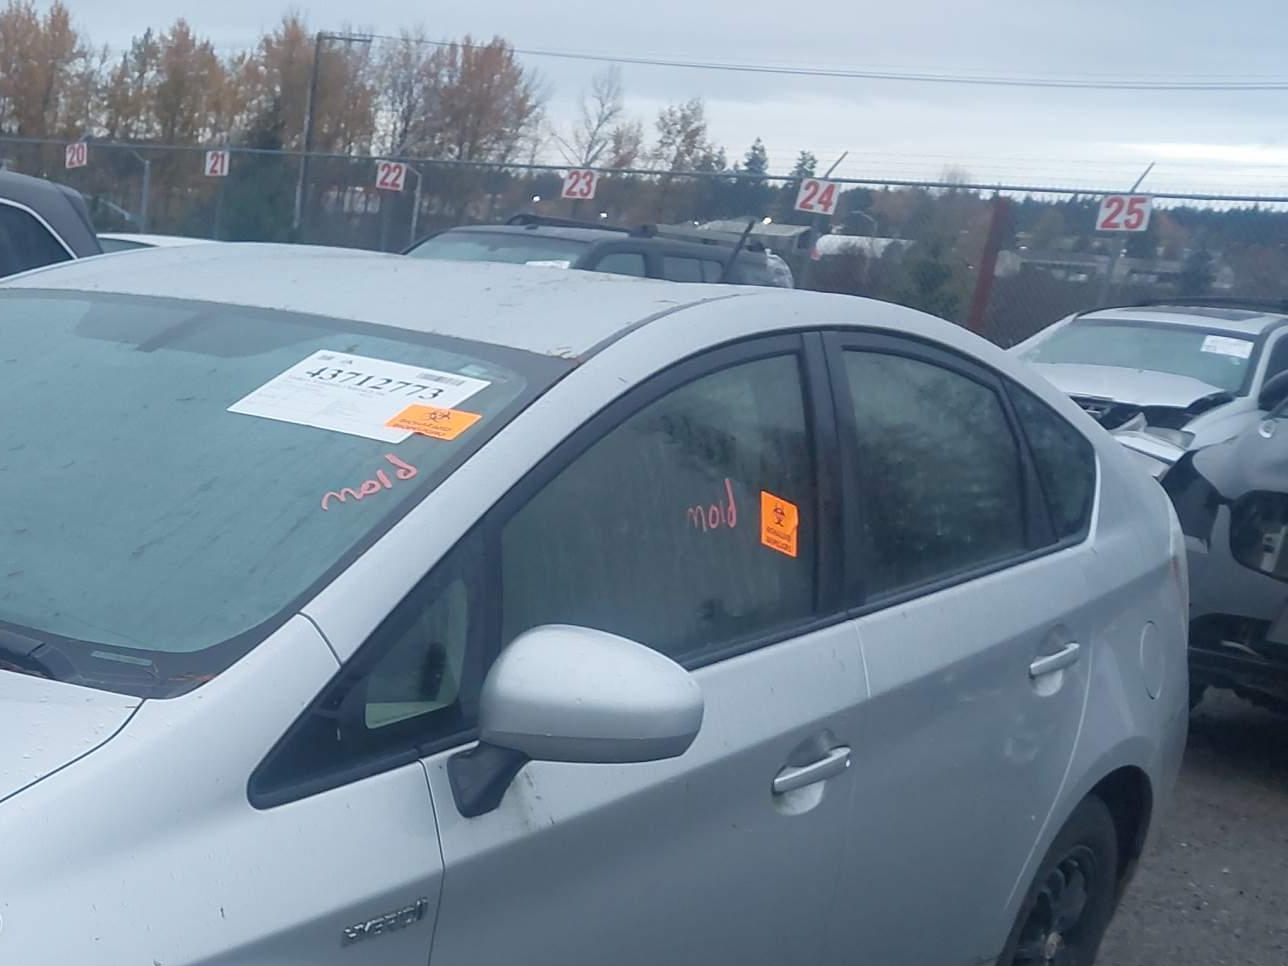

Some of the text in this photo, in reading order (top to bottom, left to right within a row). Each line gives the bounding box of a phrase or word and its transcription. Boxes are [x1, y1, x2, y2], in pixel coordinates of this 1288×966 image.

[68, 143, 87, 167] 20
[210, 152, 227, 174] 21
[379, 163, 404, 189] 22
[566, 170, 594, 197] 23
[799, 181, 834, 212] 24
[1100, 196, 1148, 230] 25
[305, 366, 445, 401] 43712773
